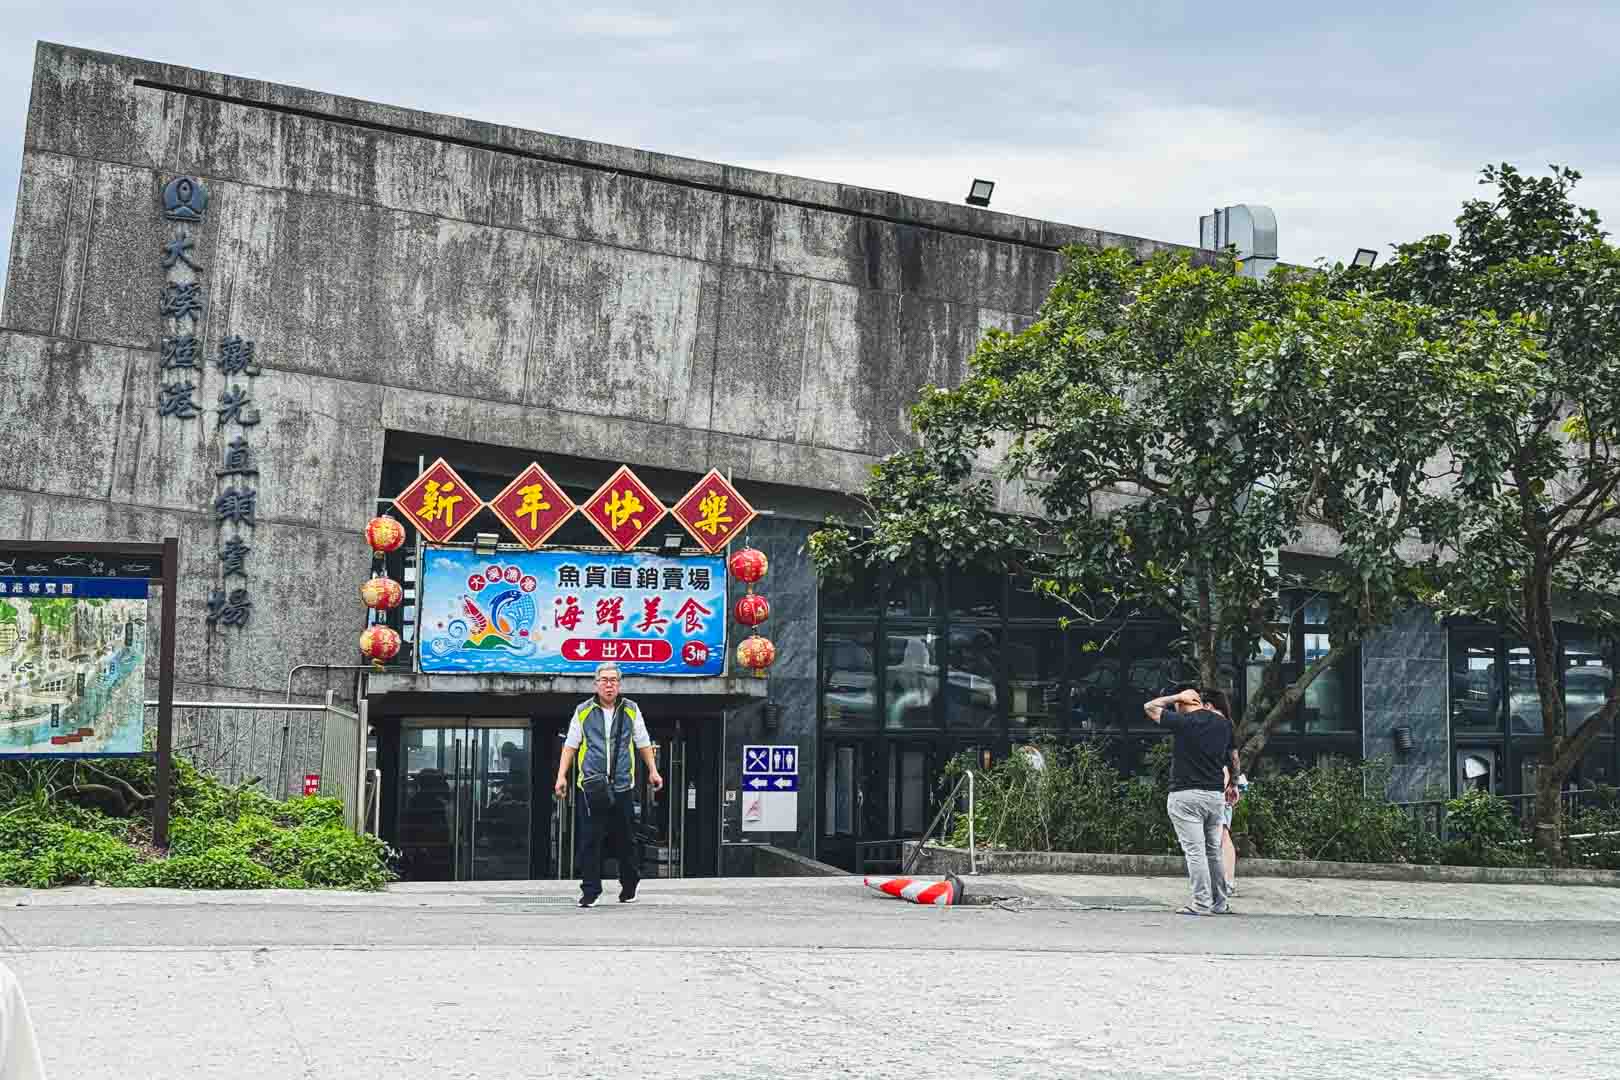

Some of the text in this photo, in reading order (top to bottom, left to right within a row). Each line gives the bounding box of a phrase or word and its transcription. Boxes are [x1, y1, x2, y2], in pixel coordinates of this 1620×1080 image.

[415, 480, 733, 535] 新年快樂
[557, 565, 711, 591] 魚貨直銷賣場
[553, 595, 712, 633] 海鮮美食
[601, 642, 653, 659] 出入口
